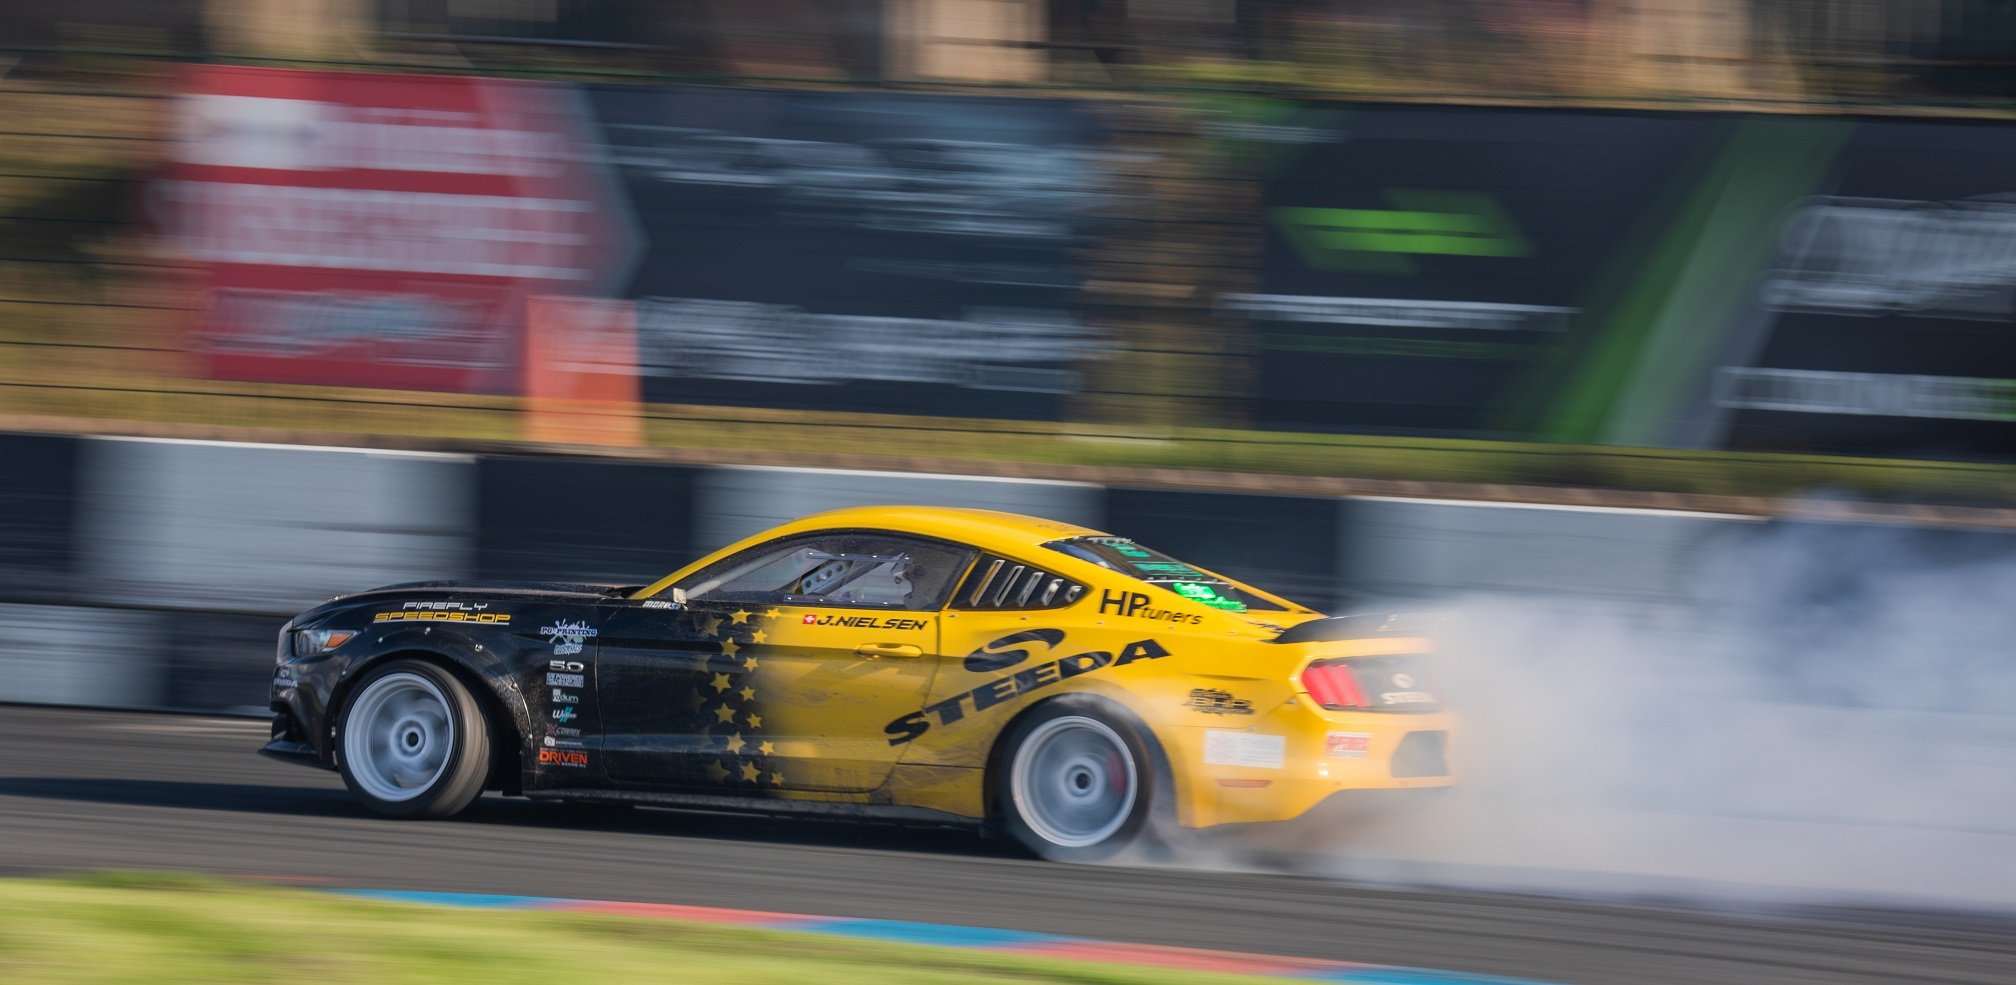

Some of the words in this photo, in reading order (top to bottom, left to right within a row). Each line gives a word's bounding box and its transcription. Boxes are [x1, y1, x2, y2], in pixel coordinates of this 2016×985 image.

[403, 601, 488, 611] FIREFLY
[375, 612, 511, 623] SPEEDSHOP
[549, 660, 585, 672] 5.0
[884, 638, 1172, 747] STEEDA
[538, 749, 588, 766] DRIVEN
